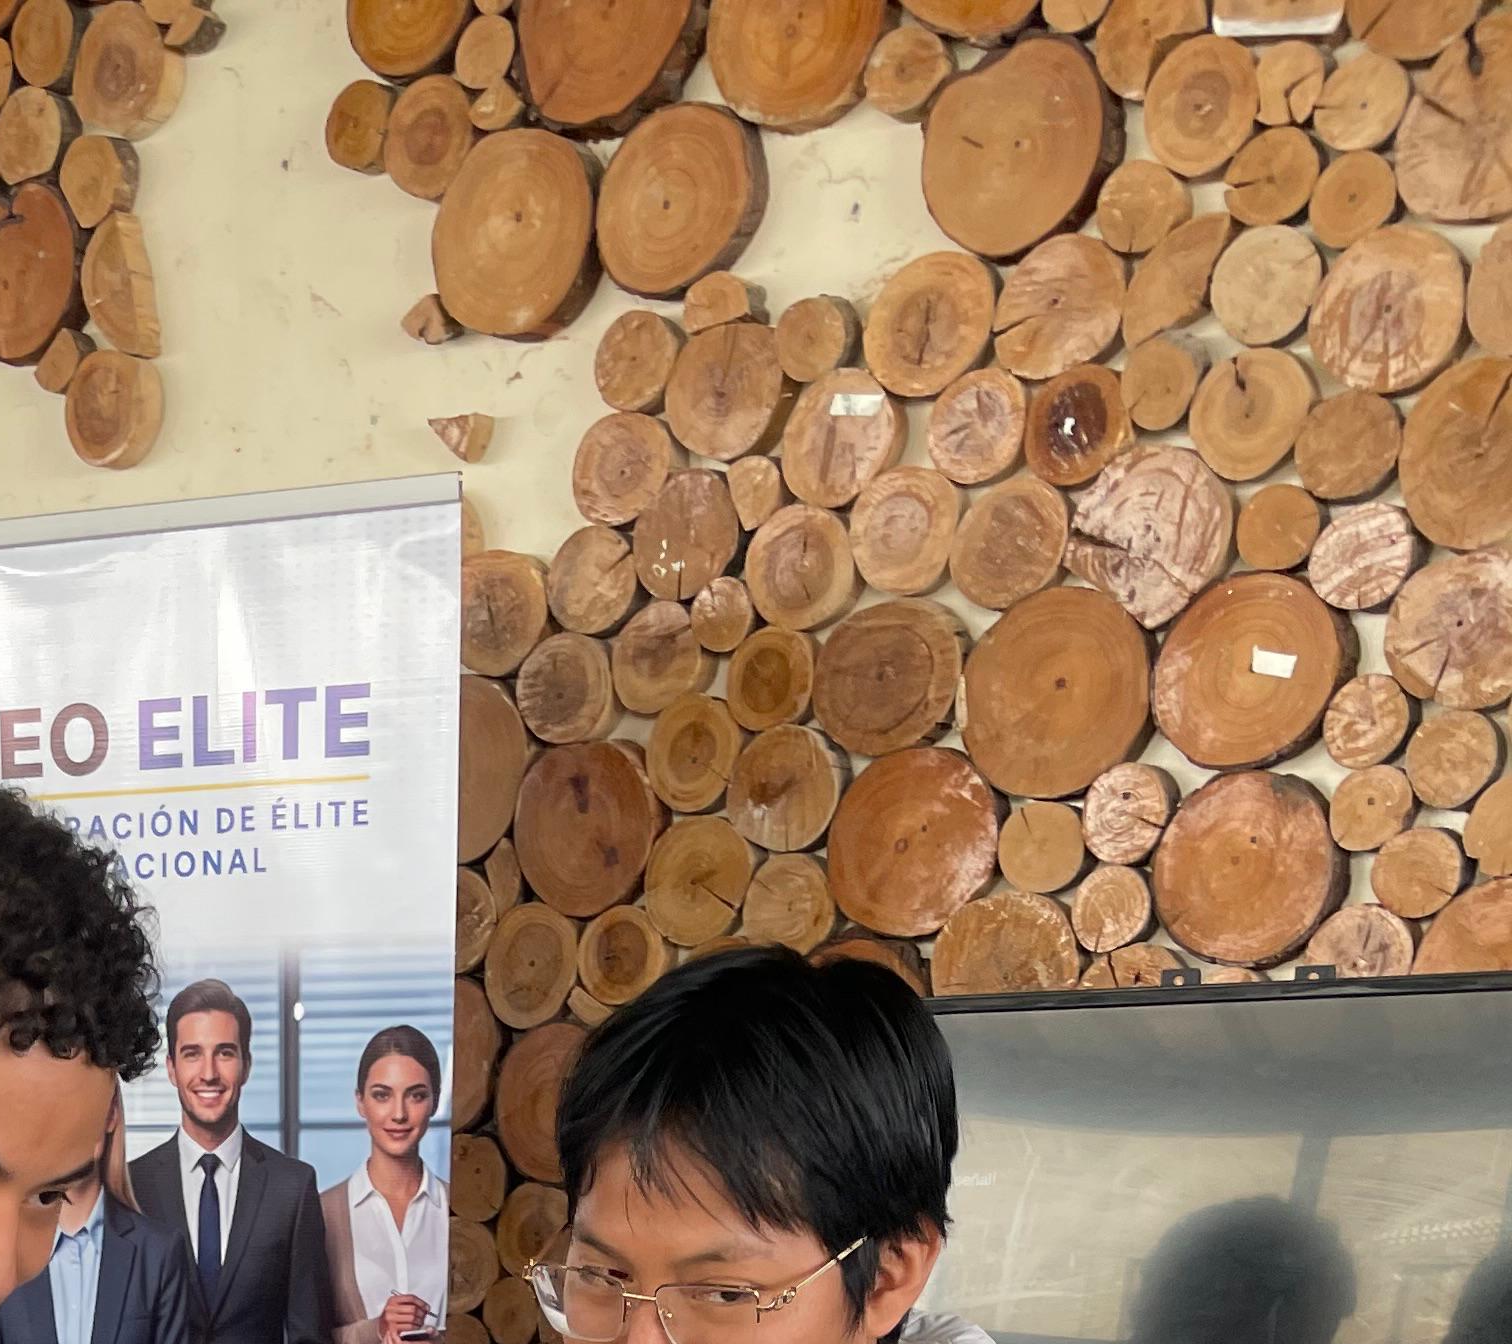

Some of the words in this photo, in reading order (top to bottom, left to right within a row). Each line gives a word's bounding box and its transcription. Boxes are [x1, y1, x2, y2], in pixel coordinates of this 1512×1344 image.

[138, 683, 371, 770] ELITE
[216, 806, 255, 833] DE
[272, 797, 369, 830] ÉLITE
